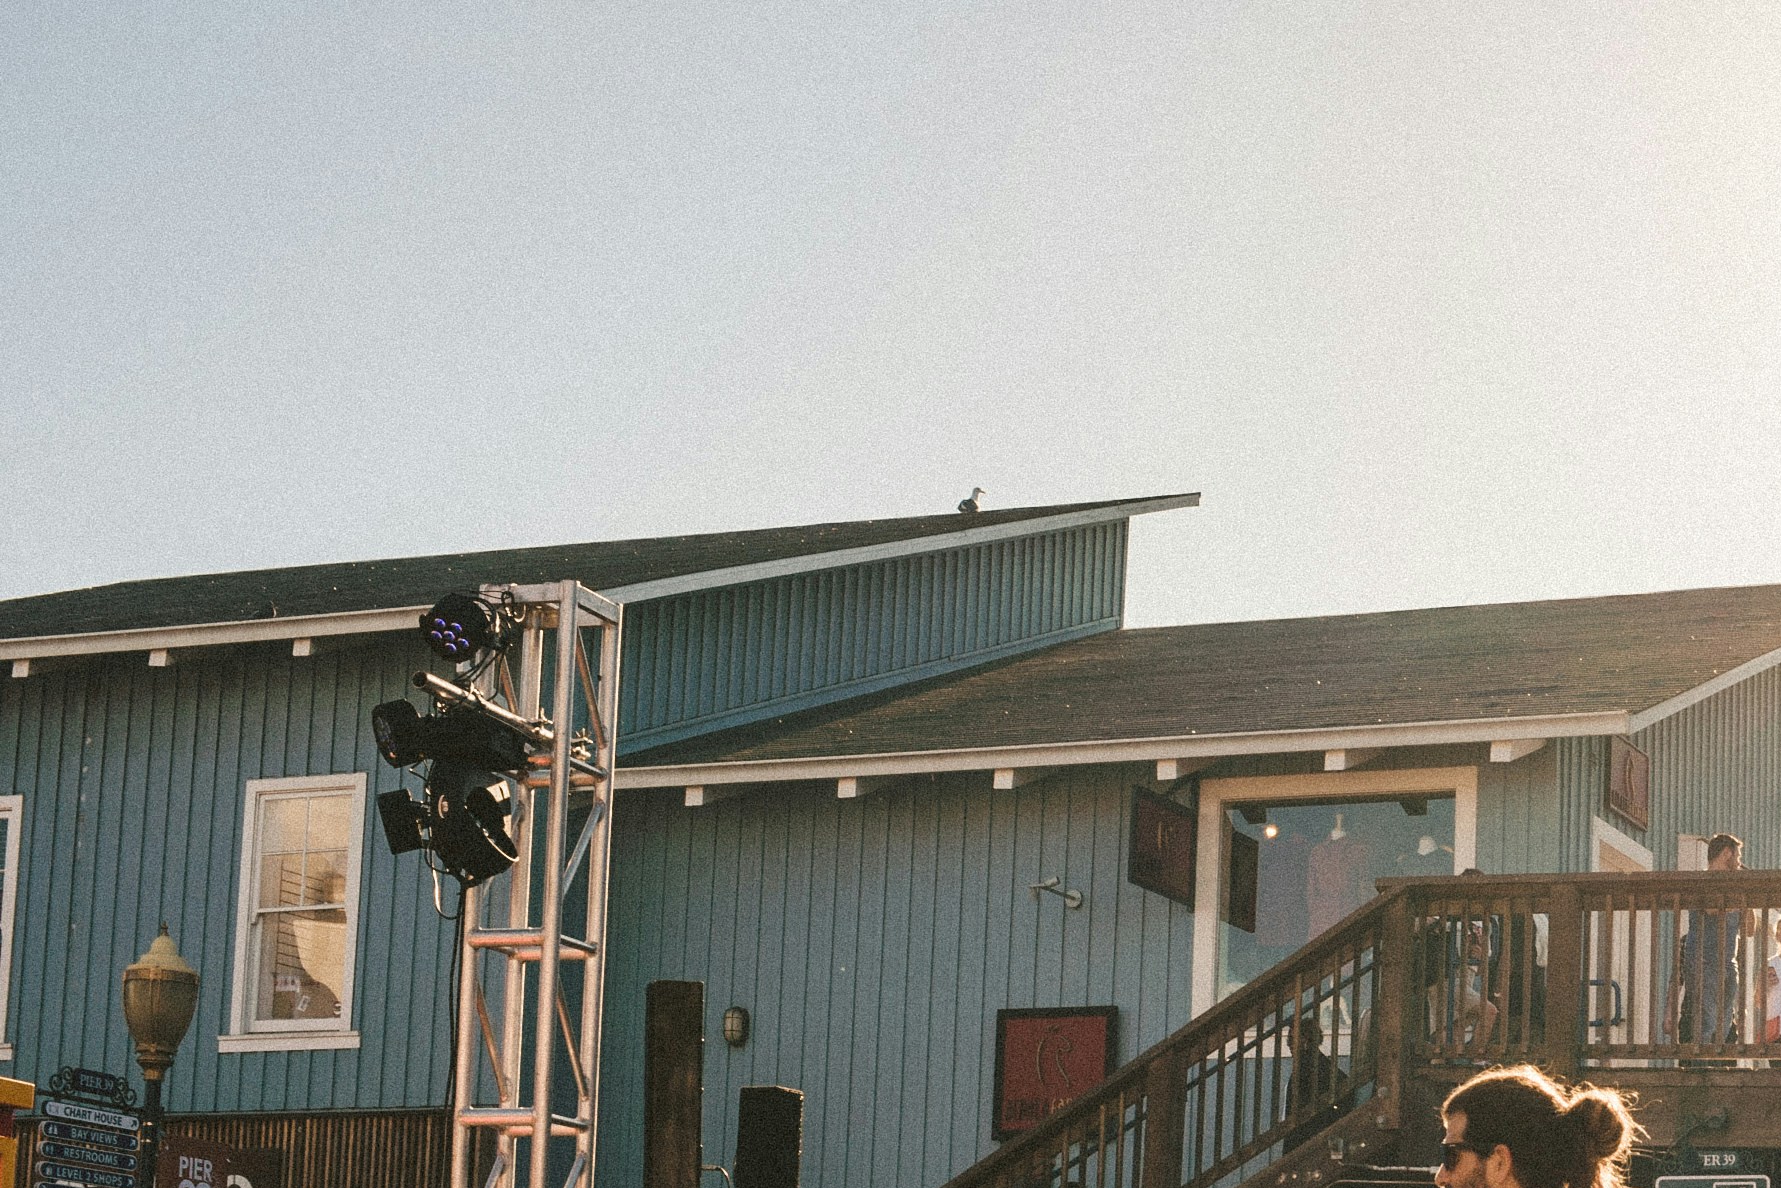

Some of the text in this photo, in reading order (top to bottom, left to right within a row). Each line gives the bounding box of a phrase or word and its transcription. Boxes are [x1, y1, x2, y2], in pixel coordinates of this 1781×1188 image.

[80, 1073, 102, 1090] PIER
[63, 1106, 122, 1126] CHART HOUSE
[70, 1127, 118, 1145] BAY VIEWS
[63, 1147, 119, 1166] RESTROOMS
[1722, 1153, 1736, 1166] 39
[56, 1167, 123, 1187] LEVEL 2 SHOPS
[178, 1155, 213, 1183] PIER
